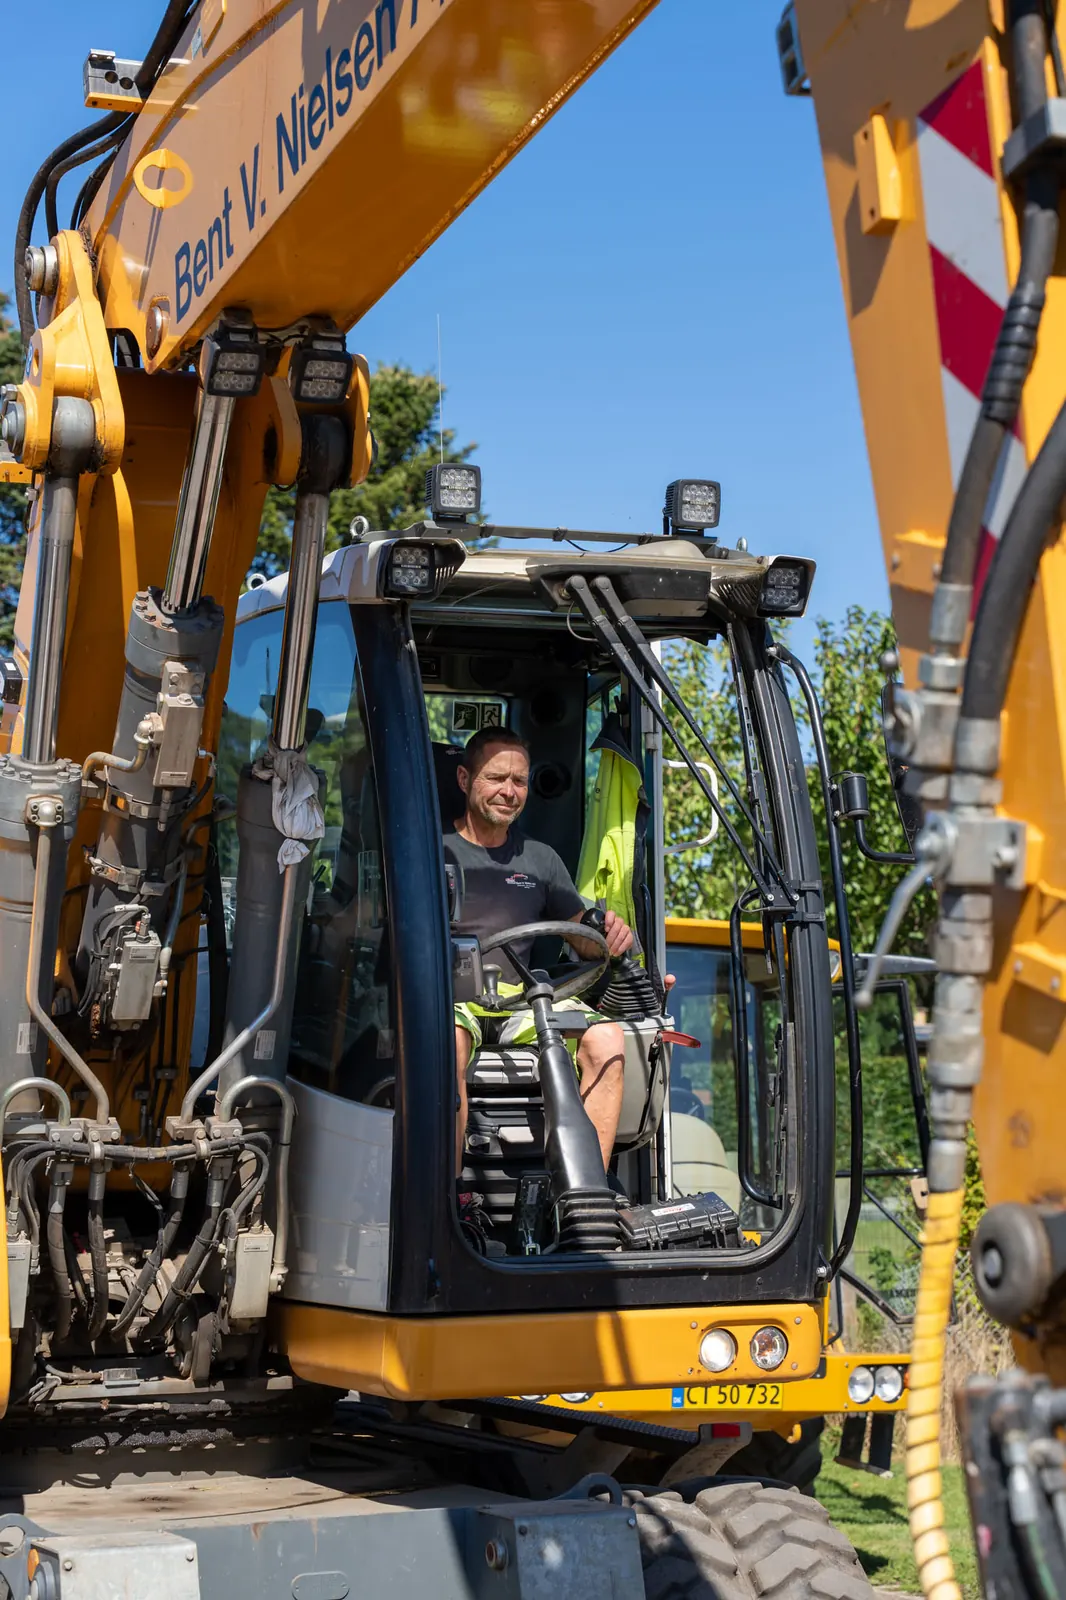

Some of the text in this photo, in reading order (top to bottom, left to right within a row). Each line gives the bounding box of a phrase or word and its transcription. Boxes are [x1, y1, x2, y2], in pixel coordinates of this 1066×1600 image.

[175, 0, 397, 324] Bent V. Nielsen
[717, 1384, 740, 1405] 50
[746, 1384, 780, 1405] 732
